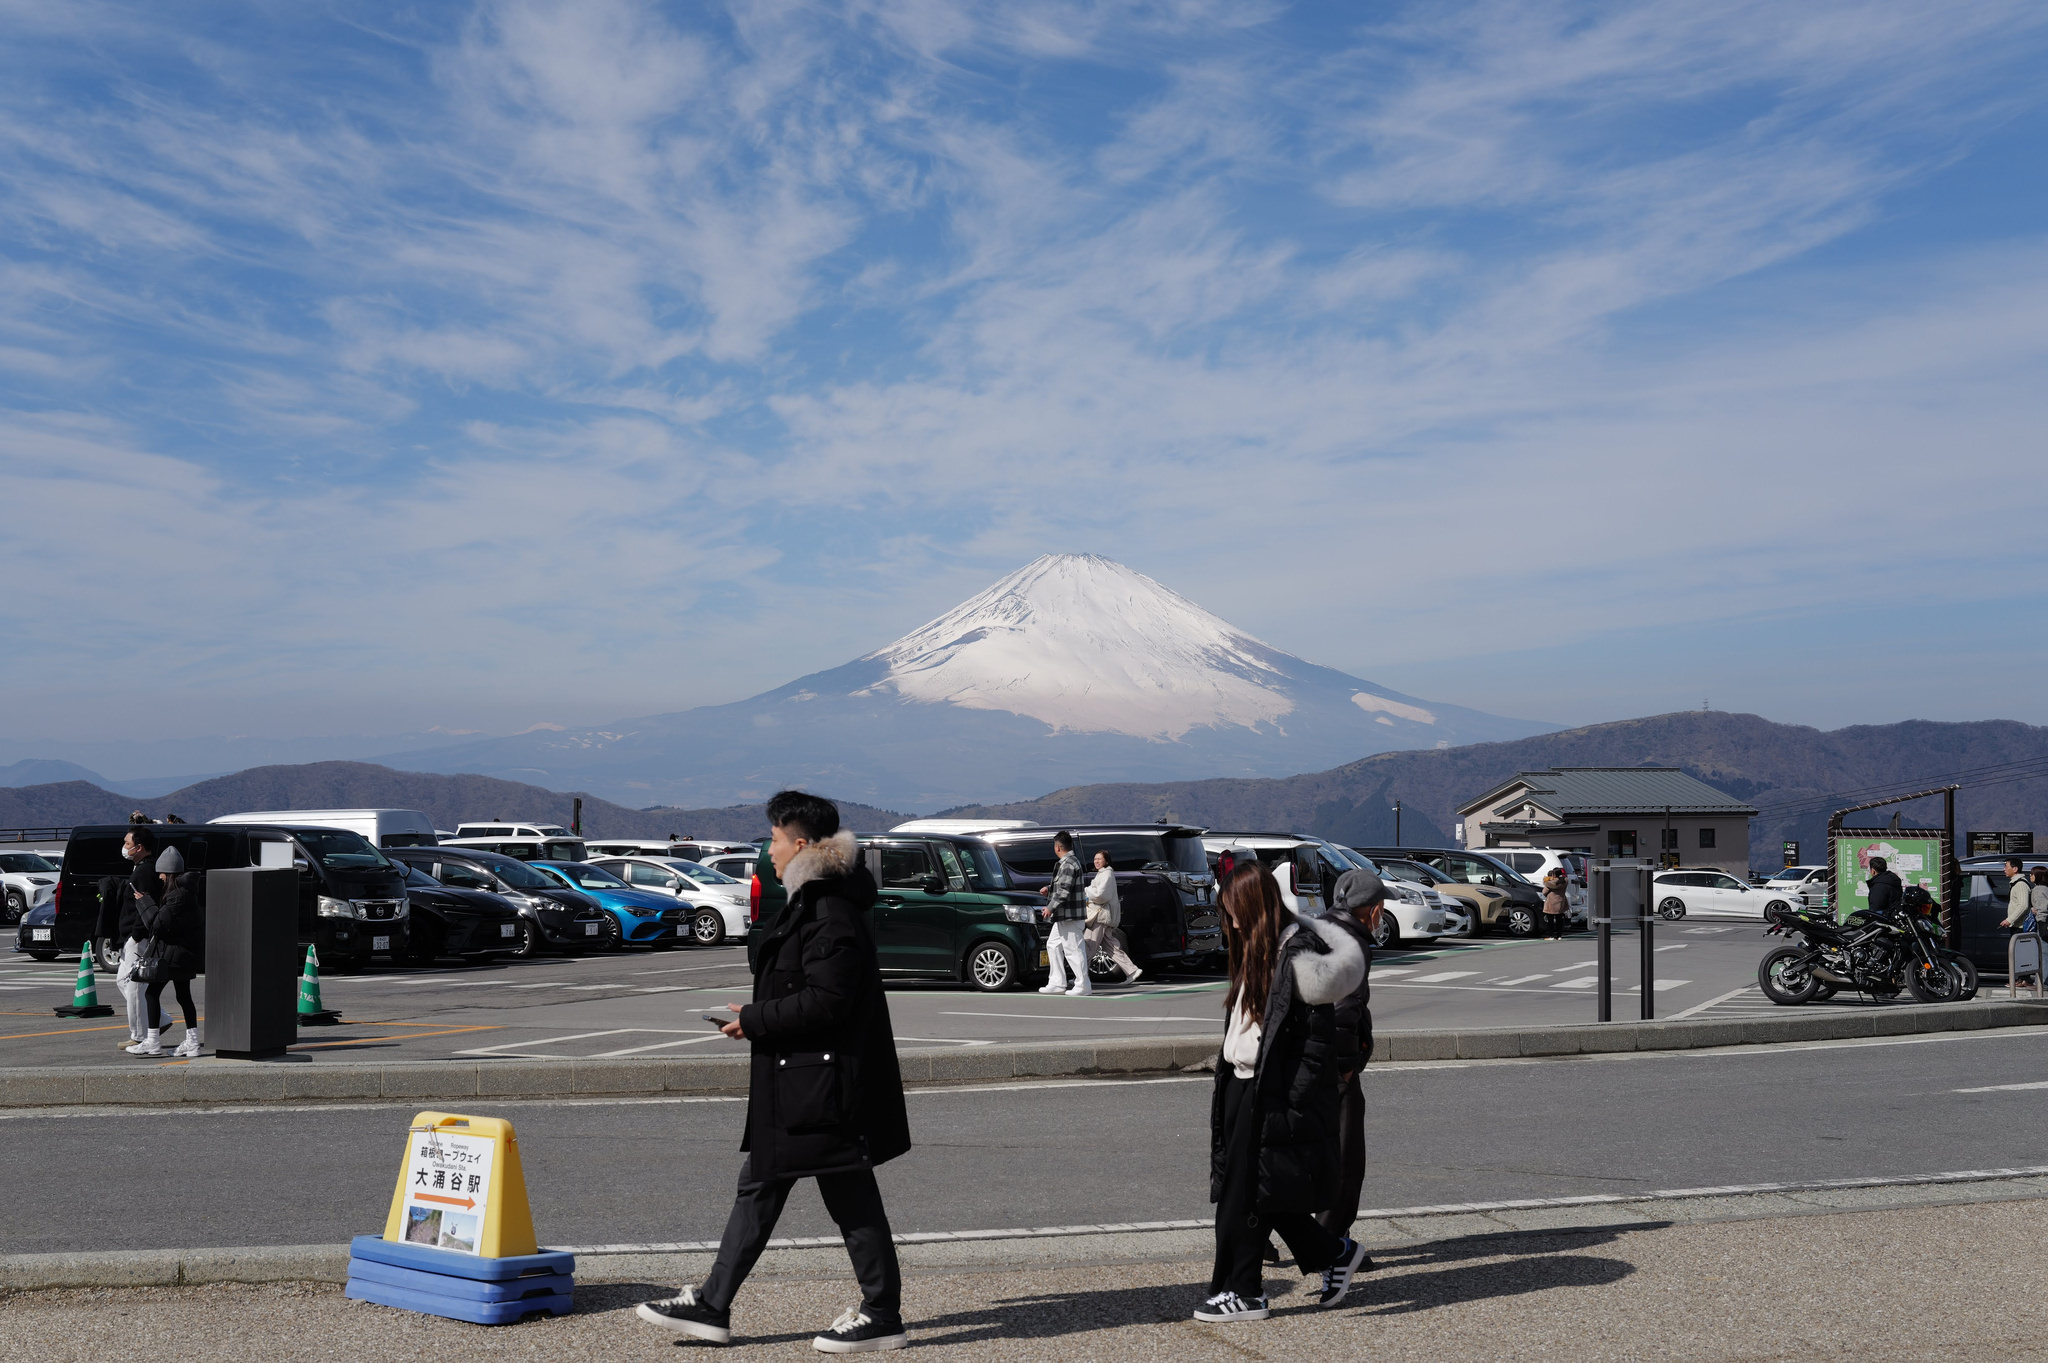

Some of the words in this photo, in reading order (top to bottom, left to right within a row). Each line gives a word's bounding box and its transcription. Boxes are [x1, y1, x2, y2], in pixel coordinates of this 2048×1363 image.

[450, 1142, 469, 1151] Ropeway
[415, 1168, 481, 1193] 大涌谷駅
